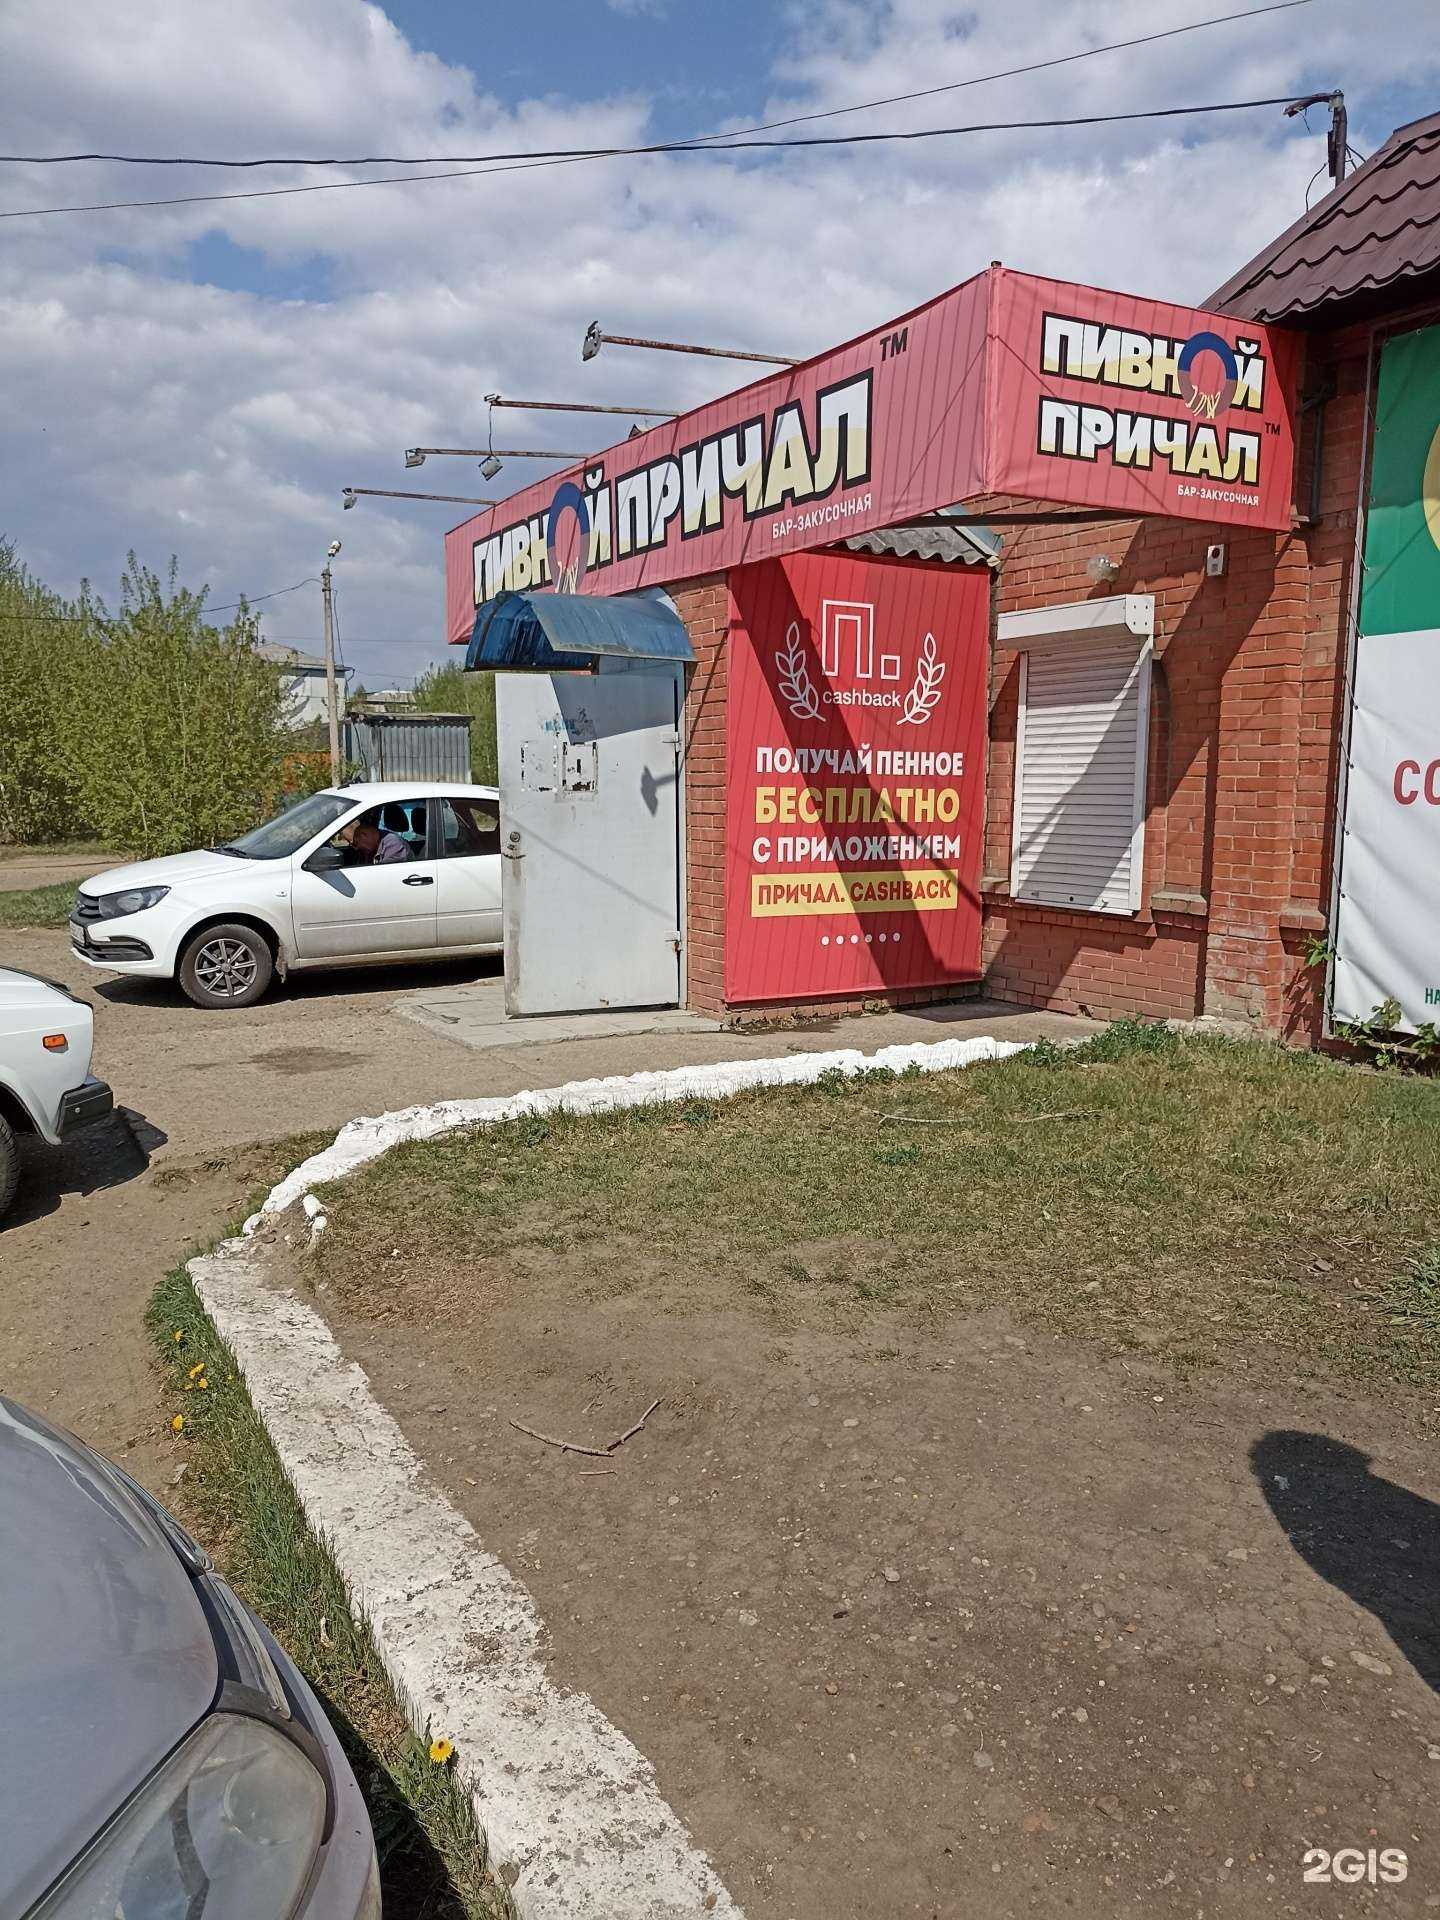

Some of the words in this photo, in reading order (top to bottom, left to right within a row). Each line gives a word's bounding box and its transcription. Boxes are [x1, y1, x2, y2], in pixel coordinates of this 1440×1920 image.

[1040, 311, 1267, 419] ПИВНОЙ
[1036, 395, 1262, 487] ПРИЧАЛ
[616, 367, 874, 560] ПРИЧАЛ
[1177, 485, 1259, 506] БАР-ЗАКУСОЧНАЯ
[771, 492, 873, 540] БАР-ЗАКУСОЧНАЯ
[822, 688, 901, 708] cashback
[756, 742, 873, 776] ПОЛУЧАЙ
[876, 750, 964, 777] ПЕННОЕ
[755, 787, 961, 824] БЕСПЛАТНО
[752, 838, 771, 863] С
[777, 834, 961, 863] ПРИЛОЖЕНИЕМ
[758, 882, 846, 906] ПРИЧАЛ.
[849, 878, 952, 903] CASHBACK
